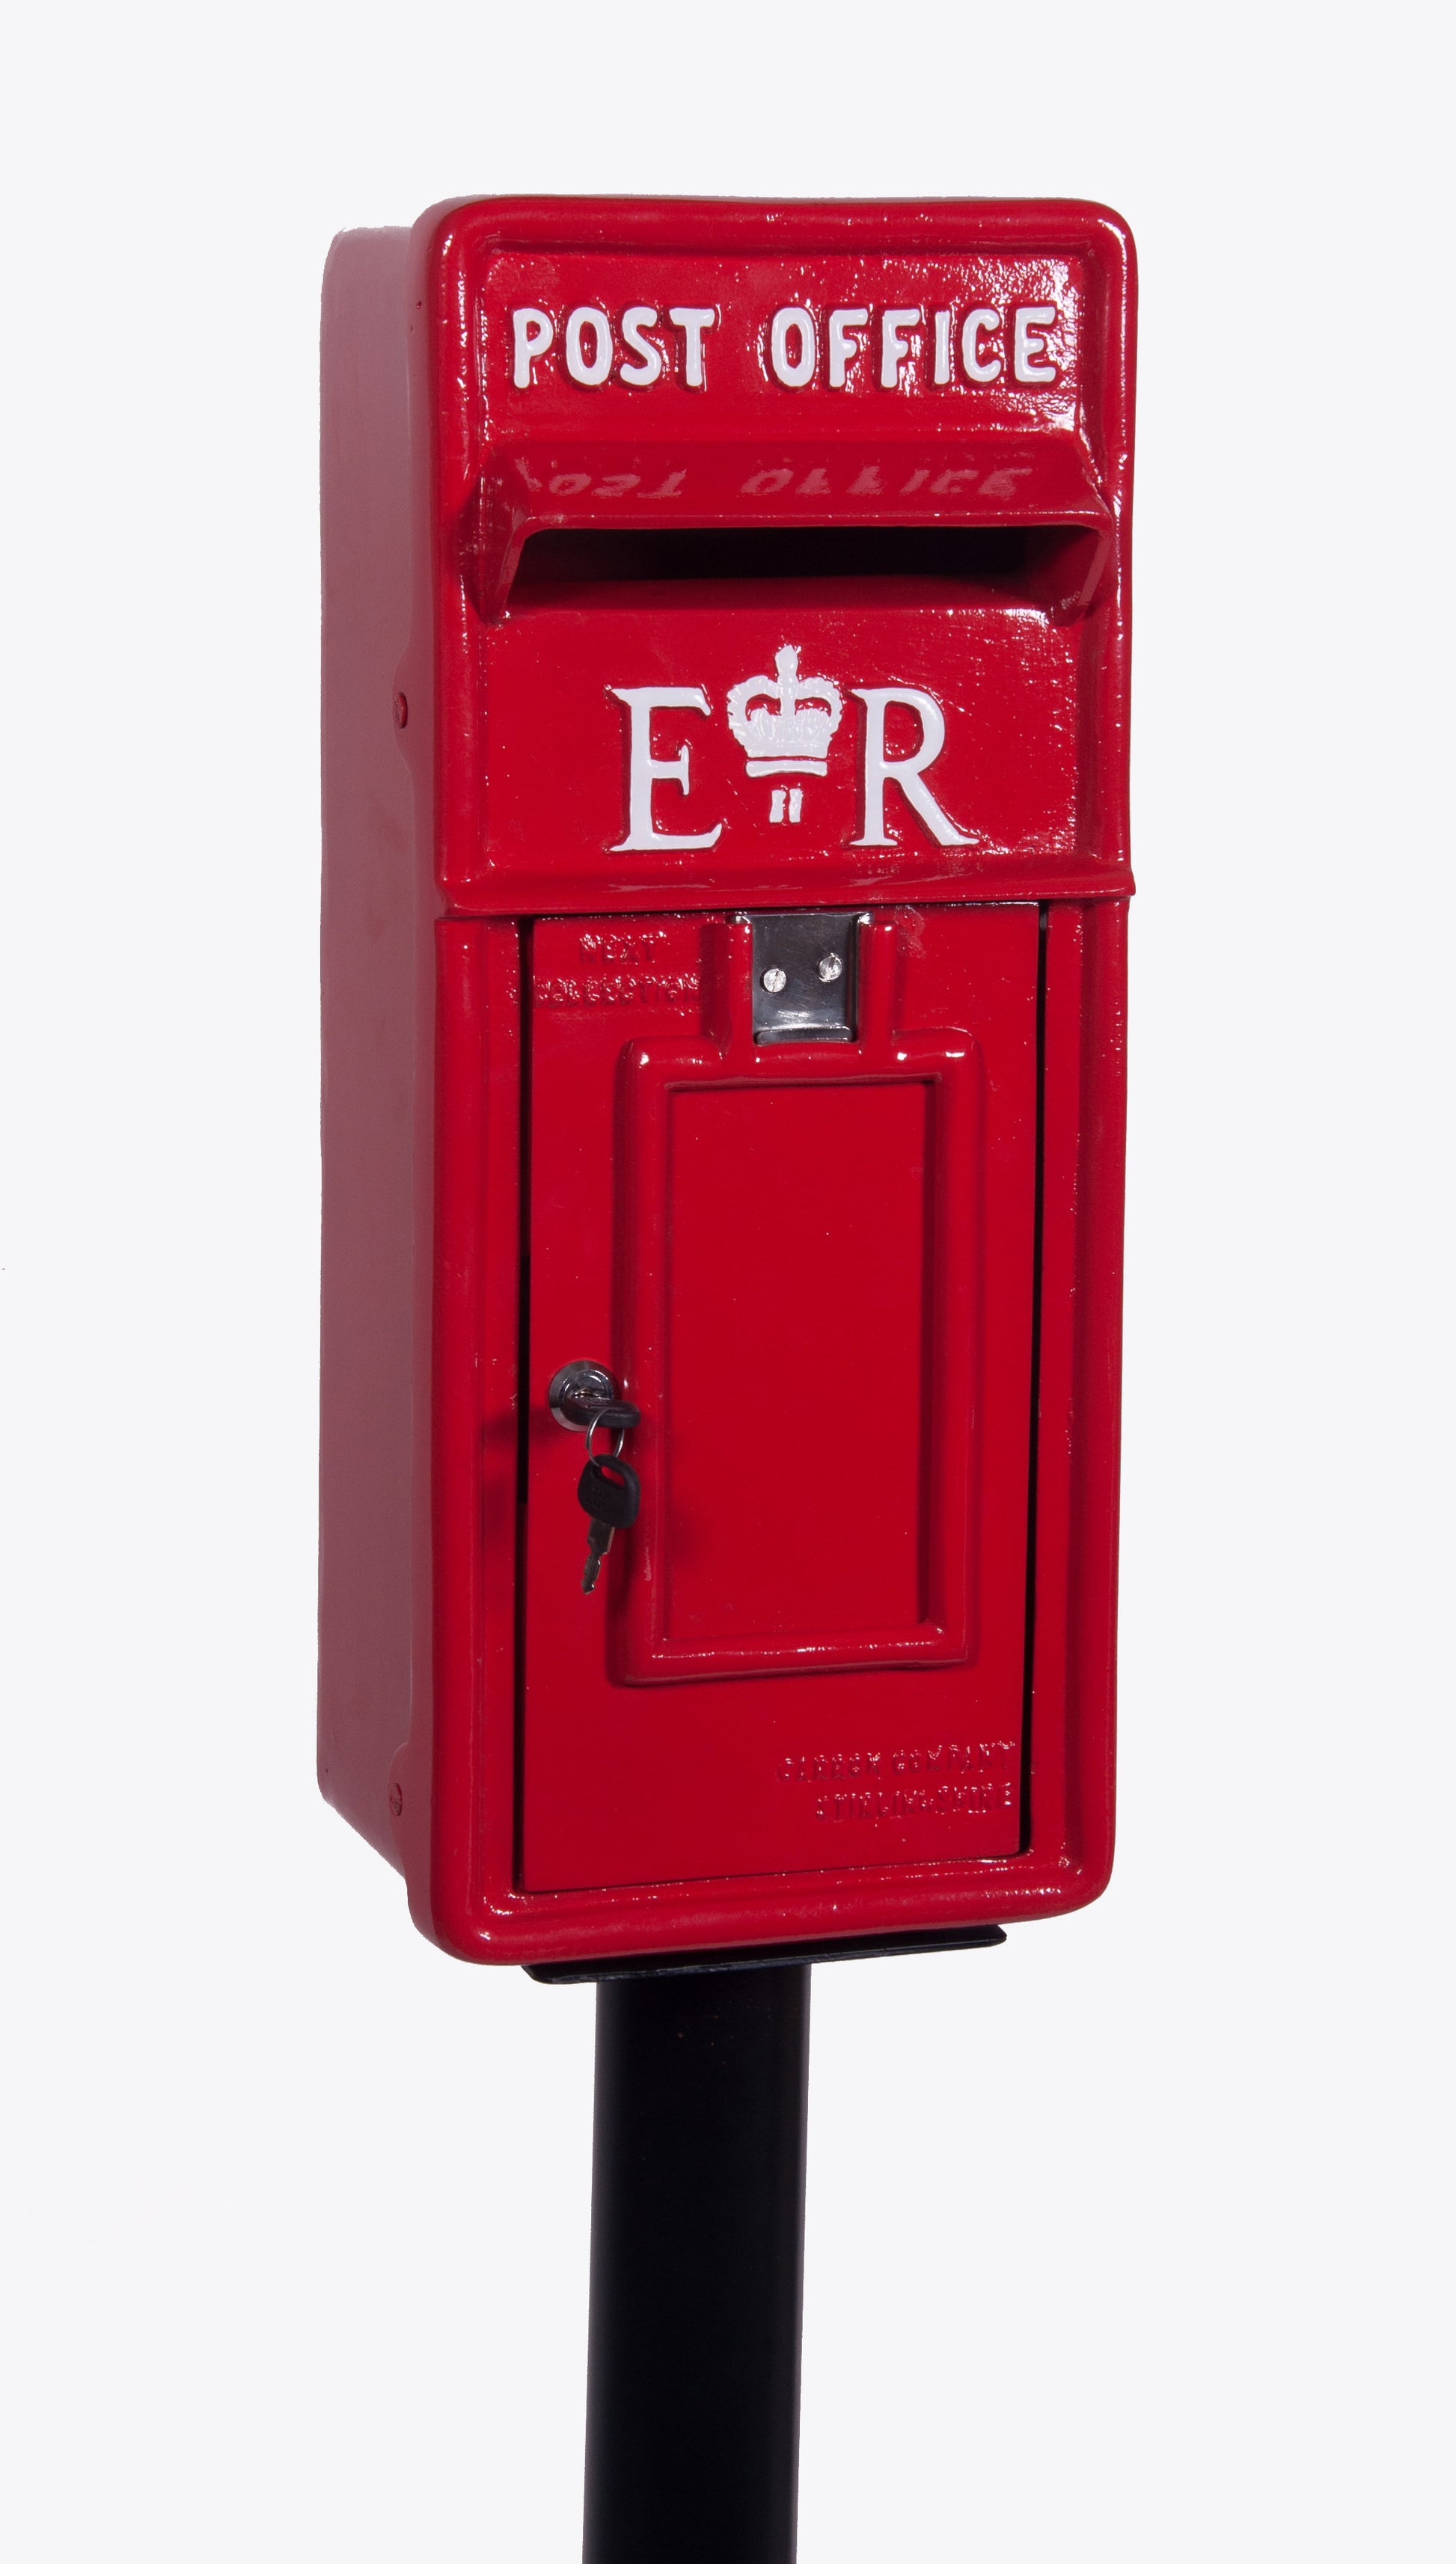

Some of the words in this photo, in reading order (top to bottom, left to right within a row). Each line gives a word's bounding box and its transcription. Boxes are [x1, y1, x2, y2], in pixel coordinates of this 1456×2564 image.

[512, 305, 715, 388] POST
[770, 305, 1058, 388] OFFICE
[610, 686, 723, 851] E
[850, 688, 980, 846] R
[579, 931, 669, 965] NEXT
